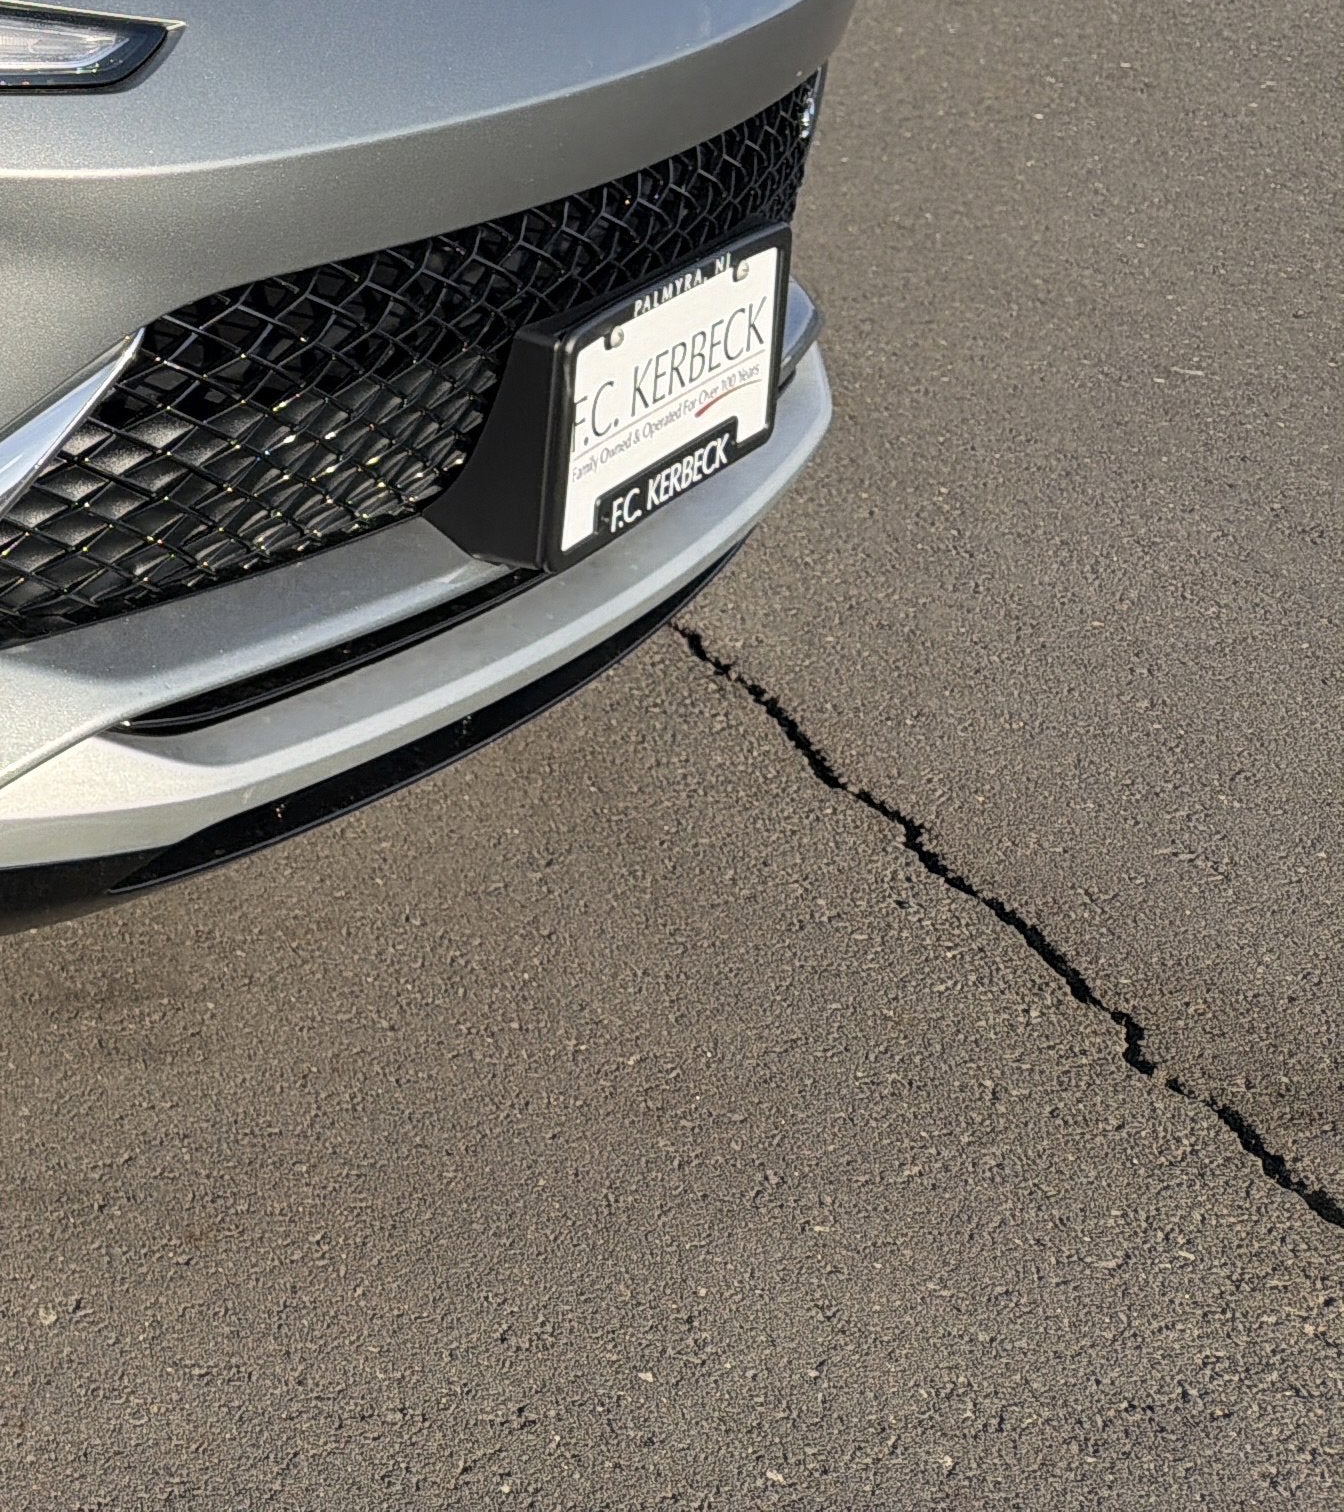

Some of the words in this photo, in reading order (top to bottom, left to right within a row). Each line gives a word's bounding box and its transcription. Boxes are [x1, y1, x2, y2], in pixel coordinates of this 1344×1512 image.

[571, 380, 619, 453] F.C.
[630, 296, 767, 417] KERBECK
[572, 454, 598, 483] Family
[600, 432, 632, 465] Owned
[642, 406, 682, 439] Operated
[683, 397, 697, 417] For
[699, 385, 719, 405] Over
[611, 488, 642, 532] F.C.
[646, 433, 730, 510] KERBECK
